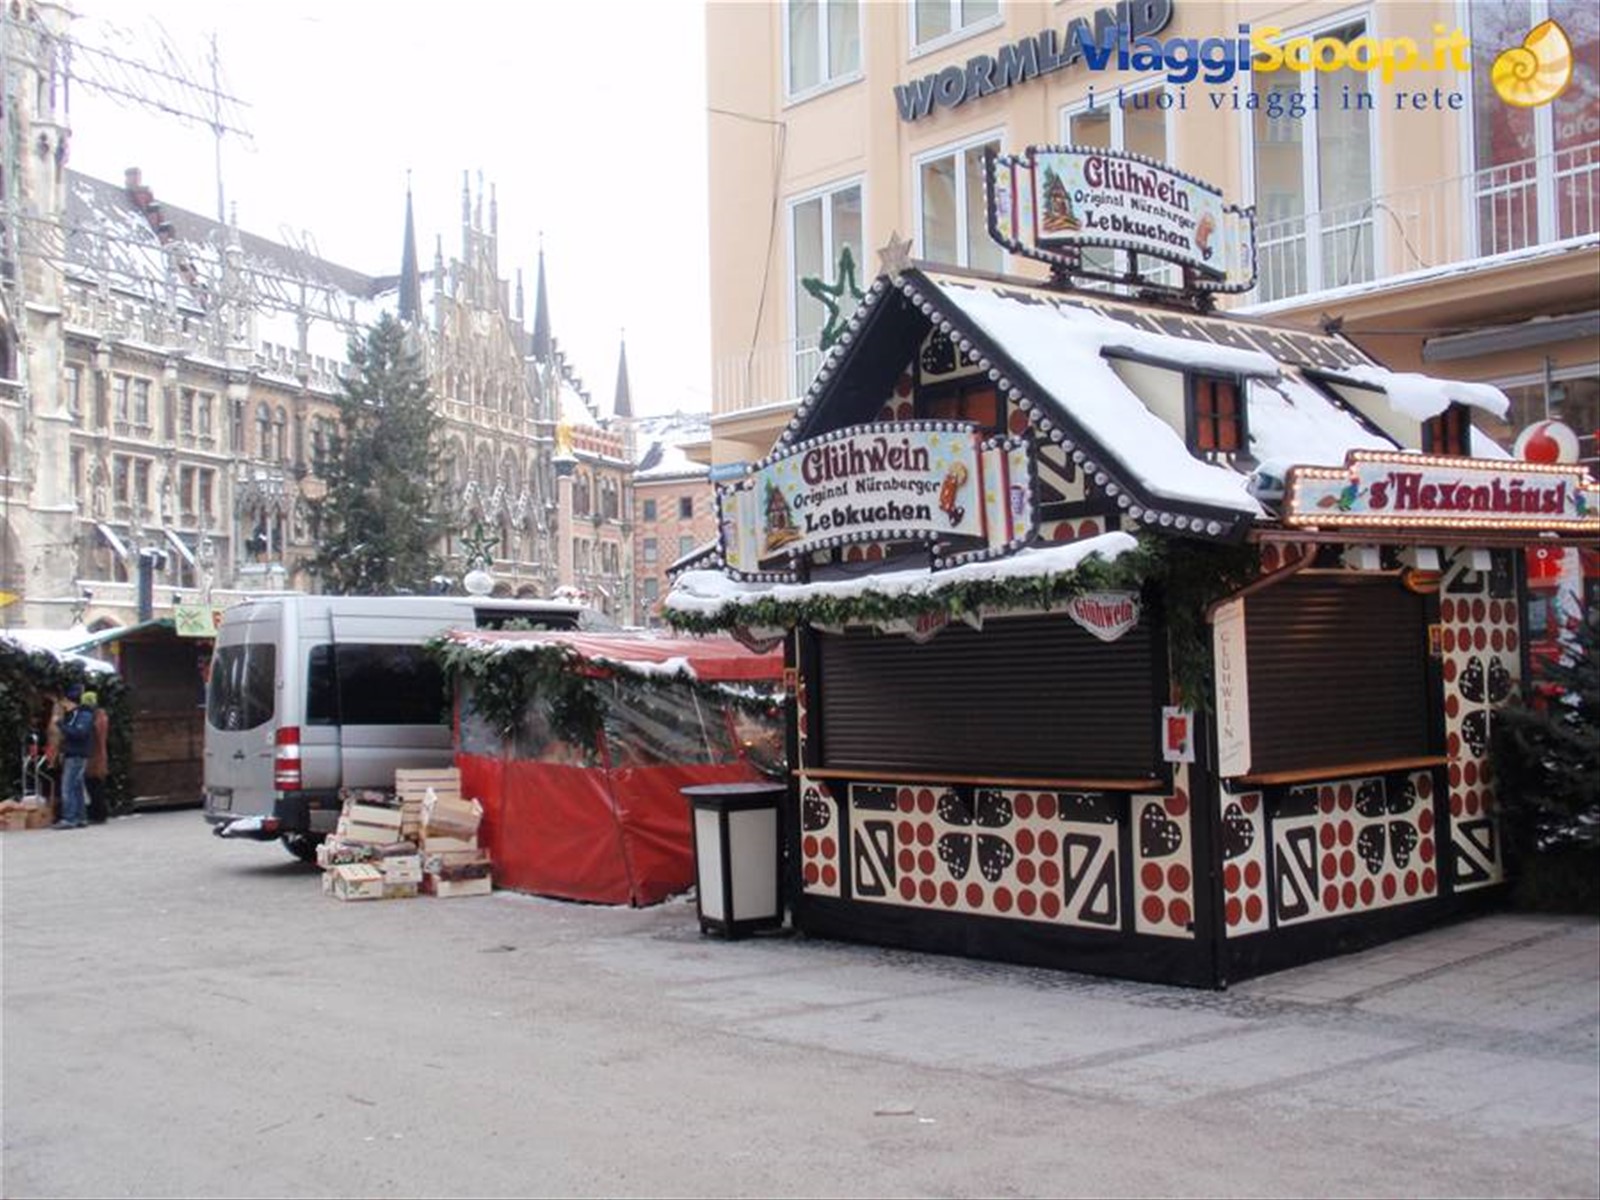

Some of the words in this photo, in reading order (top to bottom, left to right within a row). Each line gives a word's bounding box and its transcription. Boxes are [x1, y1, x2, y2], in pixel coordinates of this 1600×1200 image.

[893, 0, 1173, 122] WORMLAND
[1074, 188, 1125, 208] Original
[1083, 156, 1190, 211] Glühwein
[1085, 209, 1192, 250] Lebkuchen
[801, 437, 930, 486] Glühwein
[793, 480, 848, 510] Original
[804, 500, 932, 533] Lebkuchen
